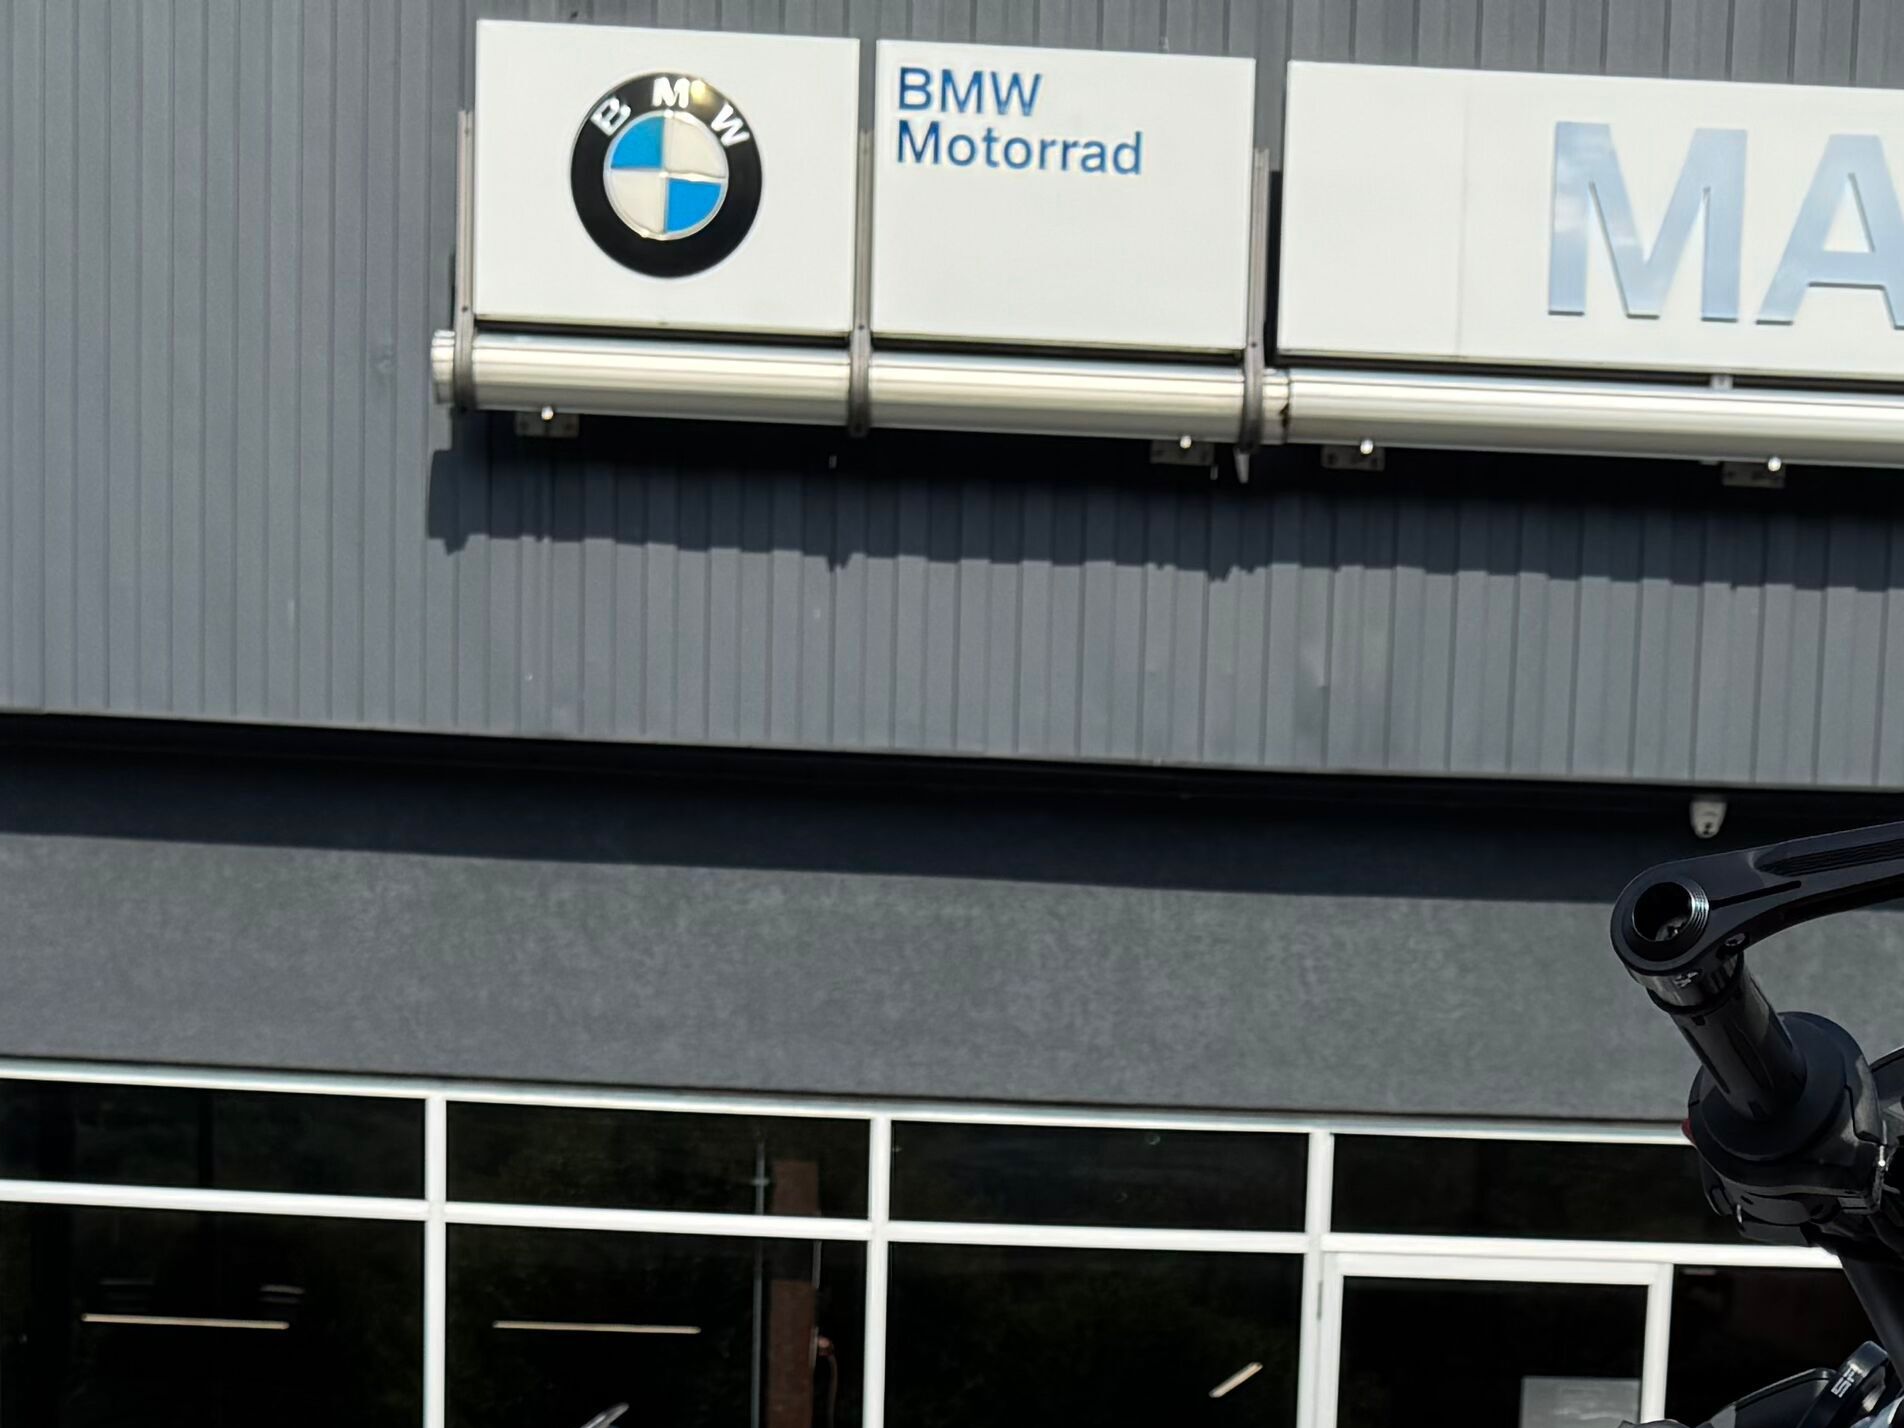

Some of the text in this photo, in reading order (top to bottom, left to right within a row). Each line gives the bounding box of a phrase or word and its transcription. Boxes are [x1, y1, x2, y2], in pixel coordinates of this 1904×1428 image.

[590, 76, 750, 148] BMW
[898, 66, 1042, 117] BMW
[896, 120, 1142, 175] Motorrad
